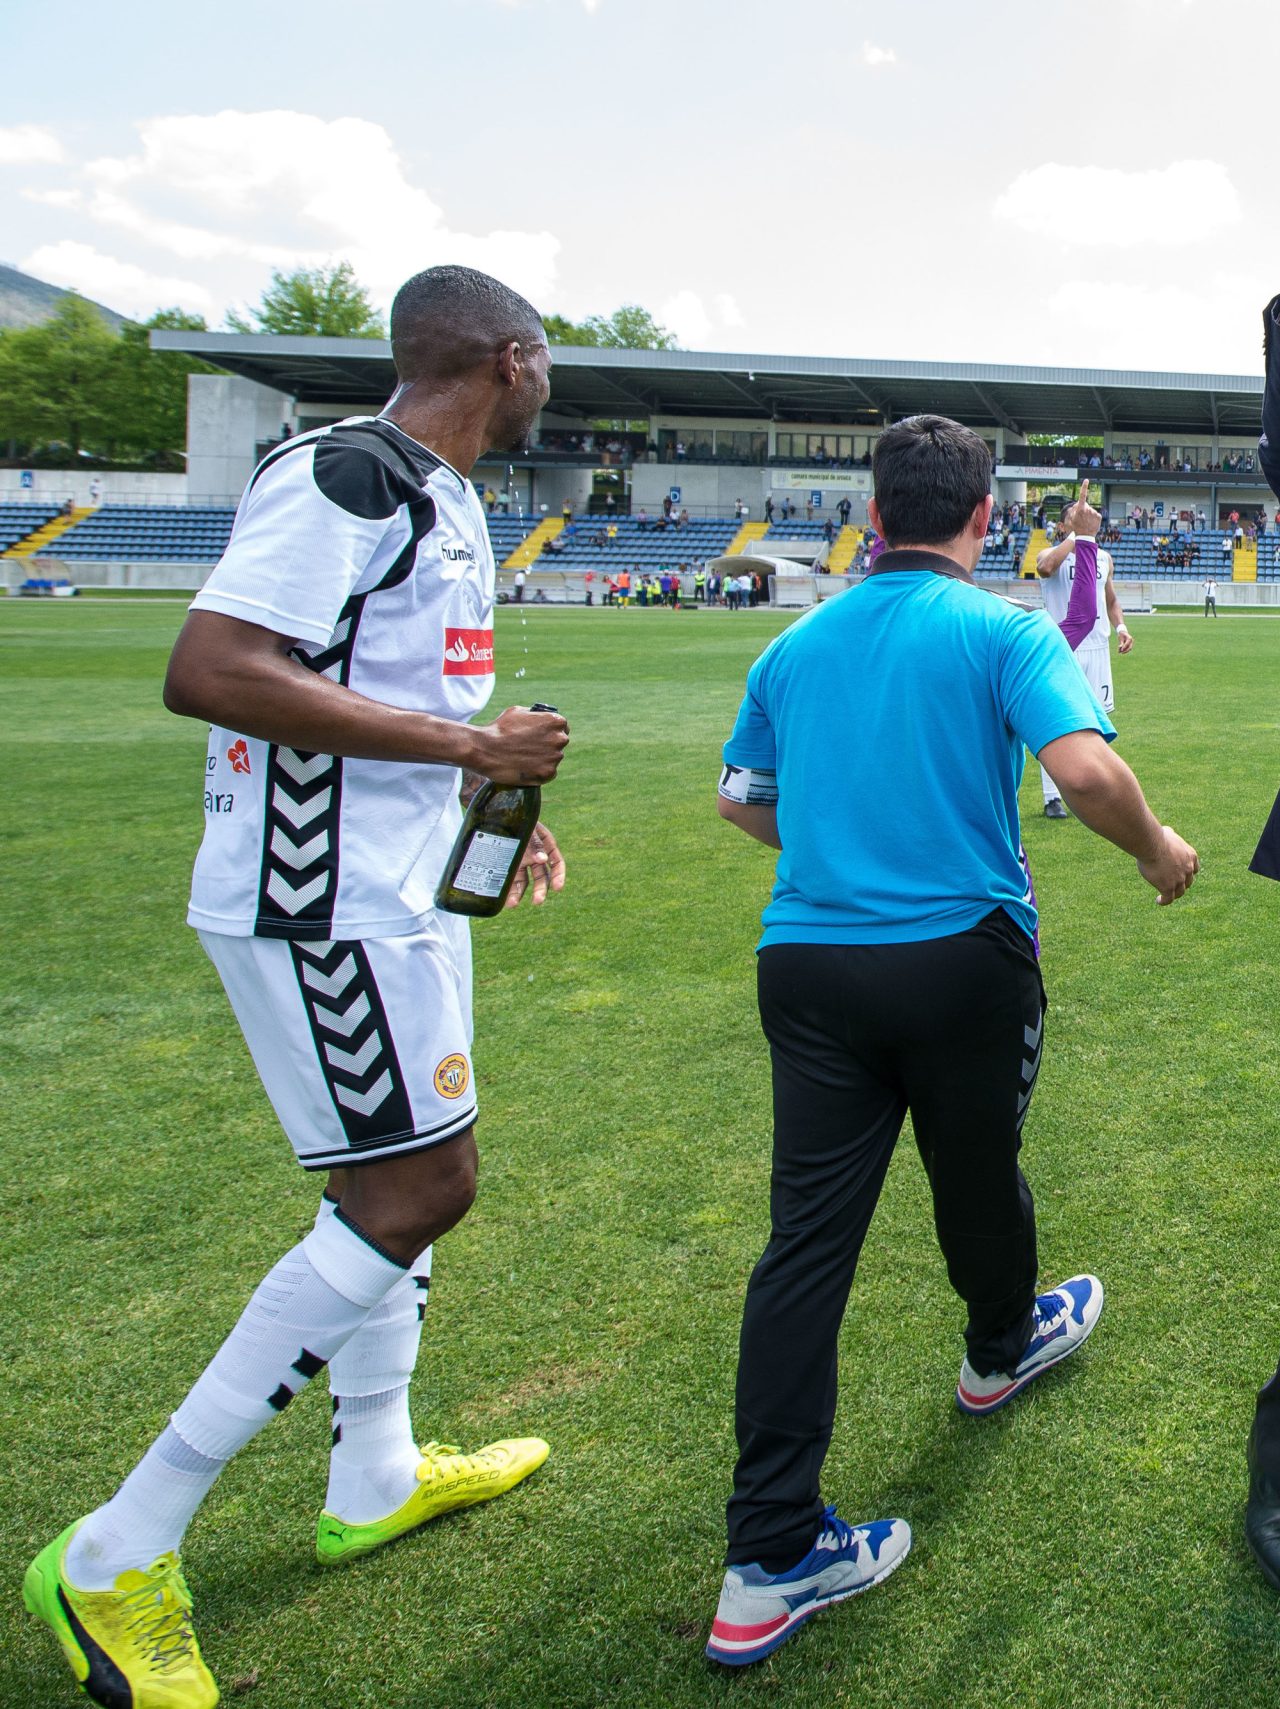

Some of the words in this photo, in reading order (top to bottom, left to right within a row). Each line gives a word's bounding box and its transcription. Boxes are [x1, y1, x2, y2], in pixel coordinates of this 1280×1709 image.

[671, 491, 680, 502] D
[813, 495, 820, 506] E
[1155, 506, 1163, 517] G
[1101, 685, 1109, 702] 7
